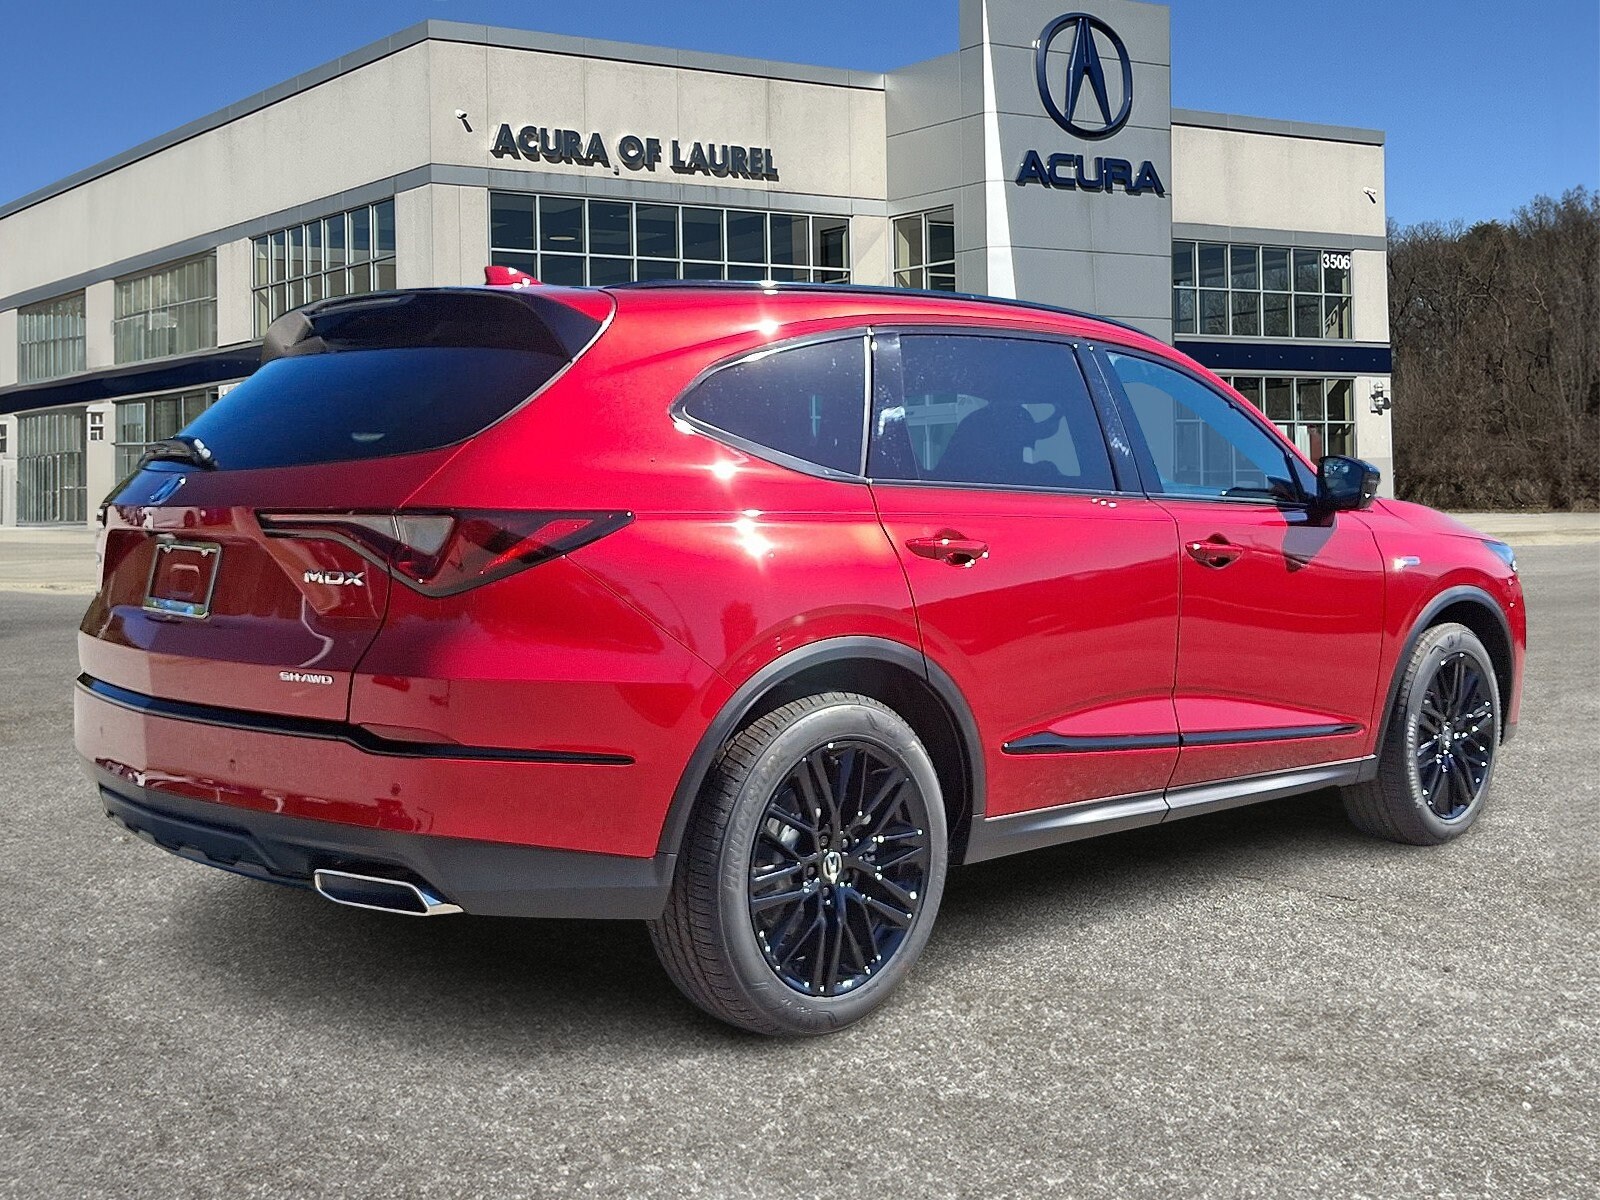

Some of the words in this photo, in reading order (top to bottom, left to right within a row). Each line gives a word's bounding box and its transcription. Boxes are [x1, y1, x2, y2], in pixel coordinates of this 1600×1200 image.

[490, 123, 611, 168] ACURA
[618, 134, 662, 171] OF
[671, 139, 779, 181] LAUREL
[1015, 150, 1165, 198] ACURA
[1322, 253, 1351, 270] 3506
[303, 569, 366, 587] MDX
